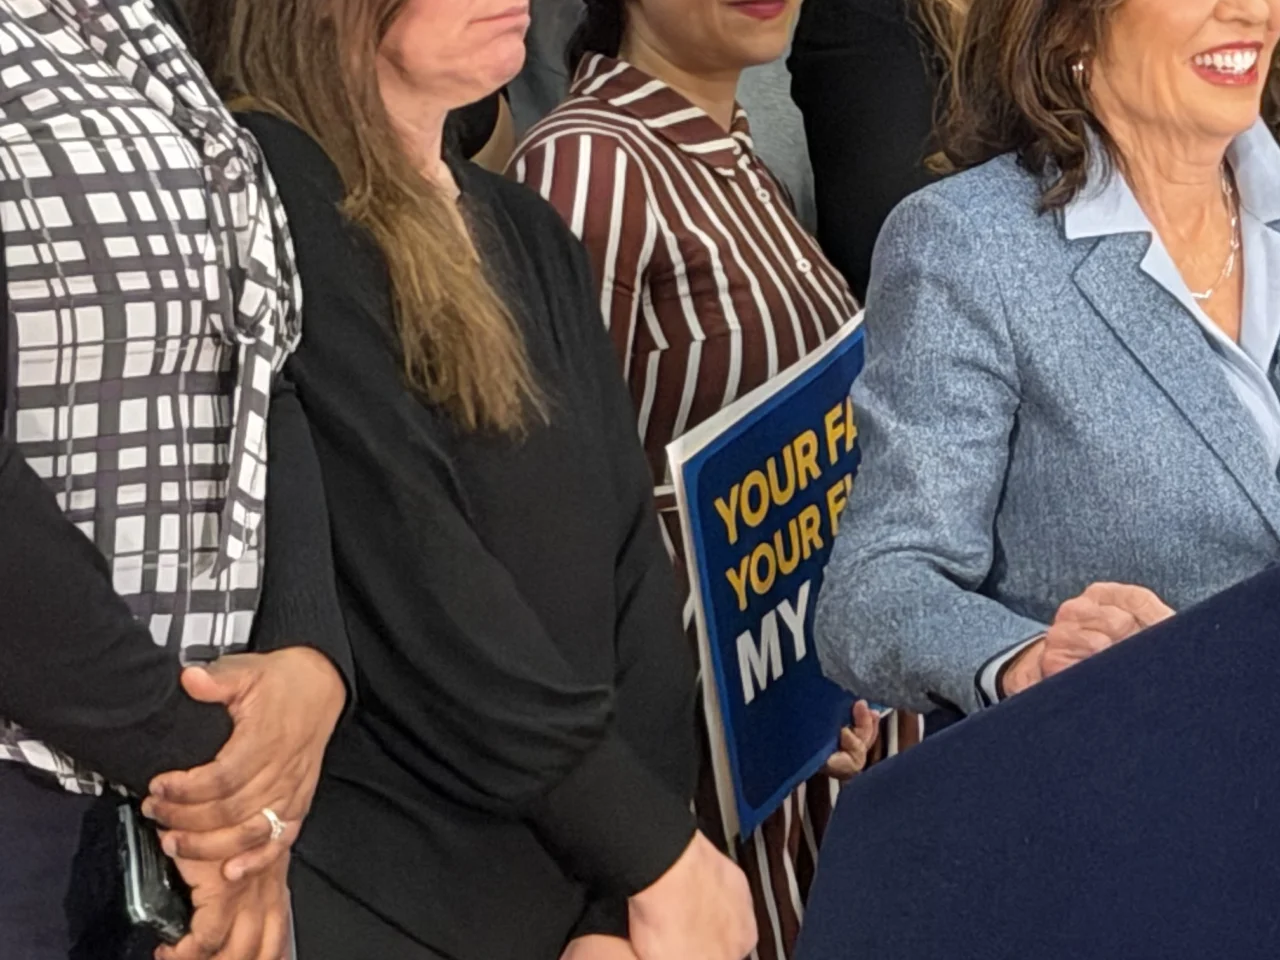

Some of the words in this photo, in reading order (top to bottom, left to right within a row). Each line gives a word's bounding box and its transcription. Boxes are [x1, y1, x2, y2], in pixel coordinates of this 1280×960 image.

[713, 429, 822, 545] YOUR
[725, 503, 824, 612] YOUR
[735, 579, 811, 705] MY
